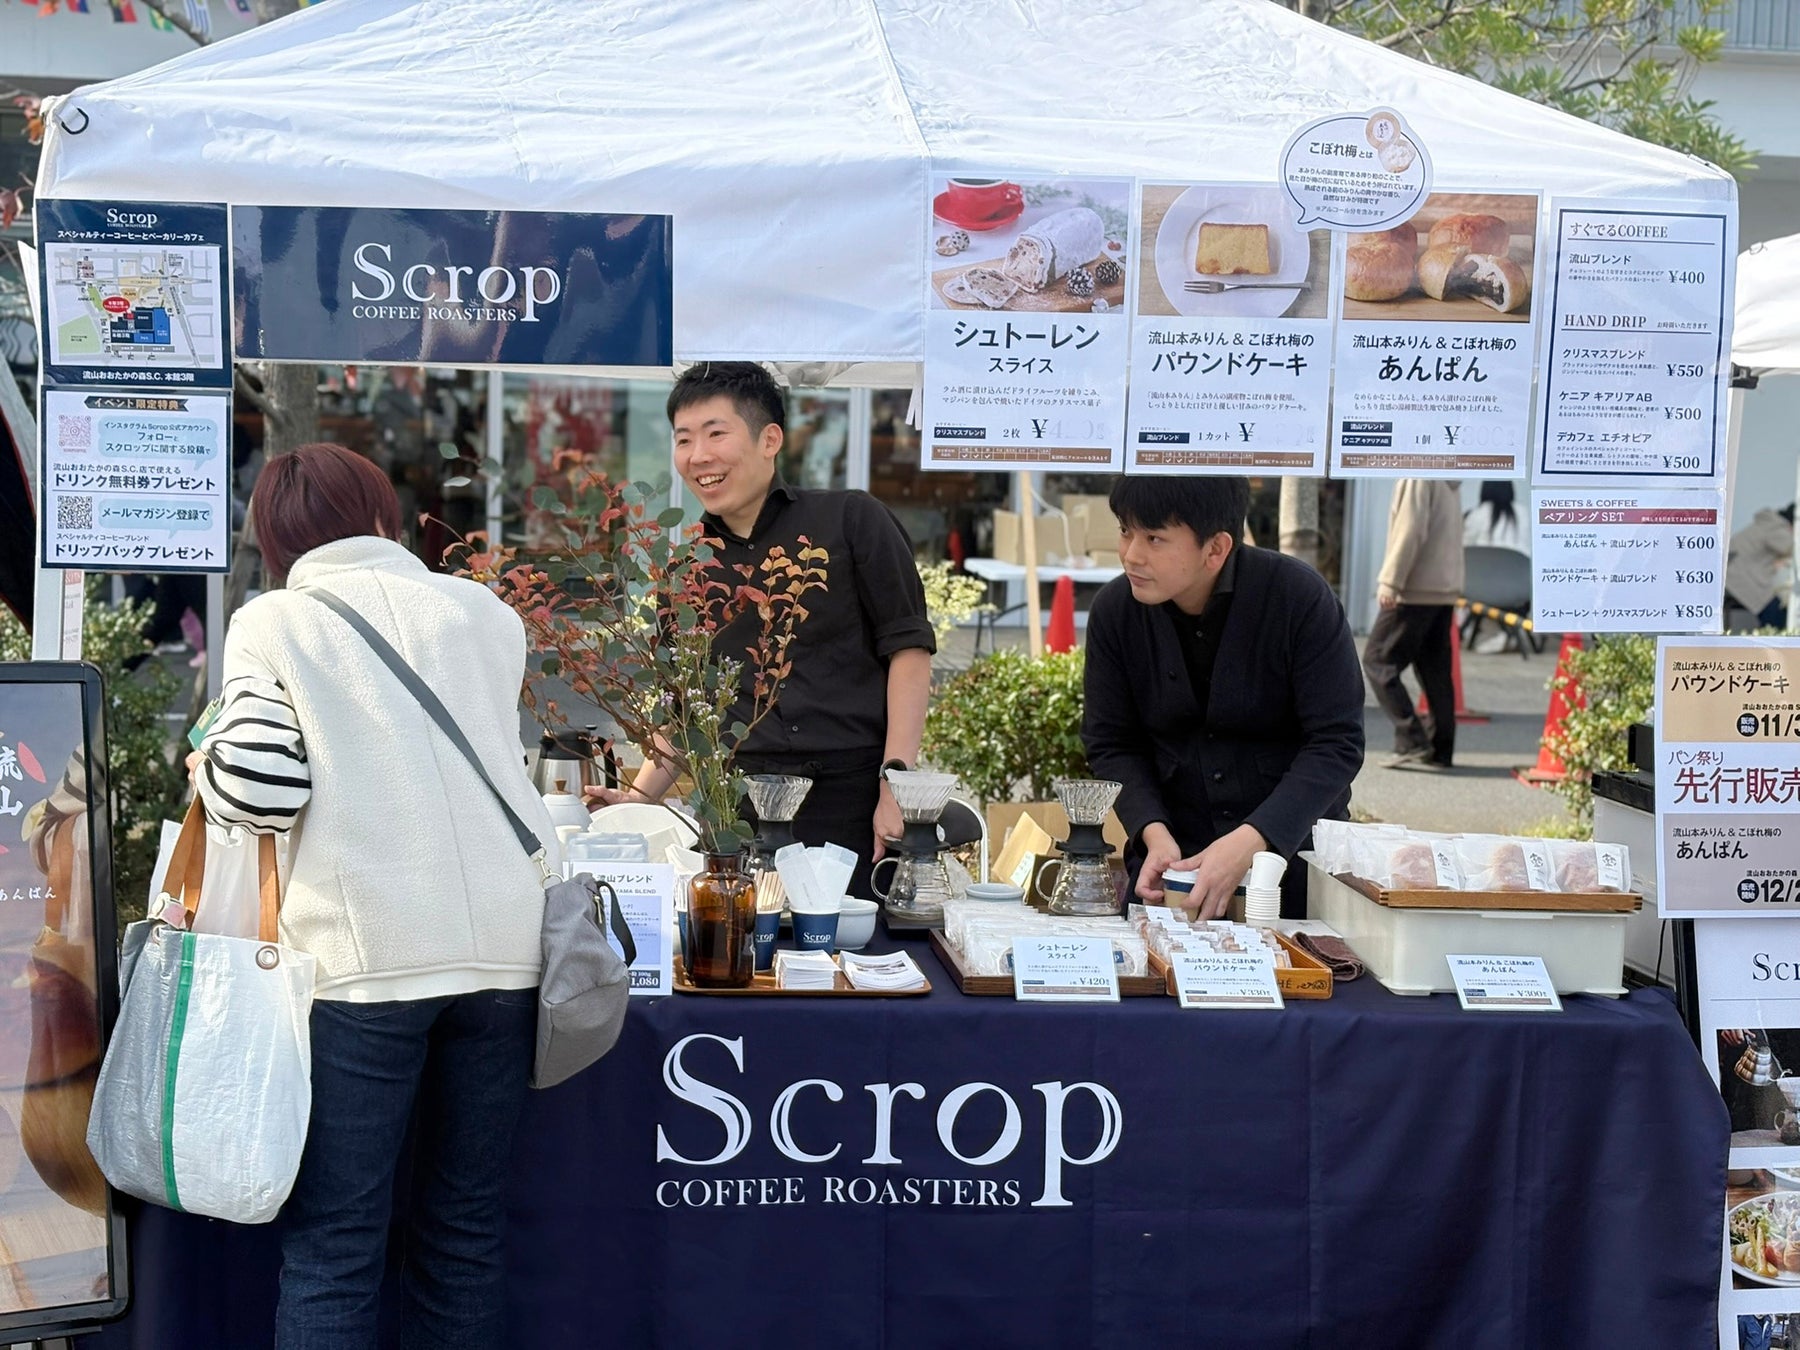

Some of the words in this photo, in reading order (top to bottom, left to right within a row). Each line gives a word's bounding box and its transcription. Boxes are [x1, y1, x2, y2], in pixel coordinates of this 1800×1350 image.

[1309, 142, 1373, 159] こぼれ梅とは
[107, 208, 158, 229] Scrop
[1570, 222, 1668, 238] すぐでるCOFFEE
[1569, 253, 1631, 265] 流山ブレンド
[352, 243, 560, 322] Scrop
[1668, 270, 1705, 284] ¥400
[352, 305, 420, 320] COFFEE
[428, 307, 516, 321] ROASTERS
[1564, 314, 1607, 327] HAND
[1612, 315, 1647, 328] DRIP
[954, 320, 1100, 349] シュトーレン
[1148, 331, 1229, 345] 流山本みりん
[1233, 332, 1244, 344] &
[1248, 332, 1314, 347] こぼれ梅の
[1352, 335, 1432, 349] 流山本みりん
[1435, 336, 1446, 349] &
[1451, 336, 1516, 351] こぼれ梅の
[1563, 348, 1645, 360] クリスマスブレンド
[988, 357, 1054, 374] スライス
[1151, 351, 1308, 376] パウンドケーキ
[1378, 354, 1488, 382] あんぱん
[1666, 363, 1703, 378] ¥550
[94, 397, 179, 409] イベント限定特典
[1559, 390, 1590, 401] ケニア
[1593, 391, 1653, 402] キアリアAB
[1664, 406, 1702, 420] ¥500
[1556, 431, 1595, 442] デカフェ
[1600, 433, 1652, 442] エチオピア
[1662, 455, 1700, 469] ¥500
[55, 474, 216, 490] ドリンク無料券プレゼント
[1540, 499, 1584, 507] SWEETS
[1586, 499, 1593, 507] &
[1596, 499, 1638, 508] COFFEE
[102, 508, 210, 521] メールマガジン登録で
[1544, 511, 1599, 522] ペアリング
[1601, 512, 1625, 522] SET
[1610, 540, 1659, 548] 流山ブレンド
[1675, 536, 1715, 550] ¥600
[1541, 574, 1598, 583] パウンドケーキ
[1610, 574, 1657, 583] 流山ブレンド
[1675, 570, 1714, 584] ¥630
[1541, 609, 1589, 618] シュトーレン
[1601, 608, 1668, 618] クリスマスブレンド
[1675, 605, 1713, 618] ¥850
[1672, 662, 1726, 671] 流山本みりん
[1727, 662, 1735, 671] &
[1737, 662, 1781, 671] こぼれ梅の
[1671, 675, 1789, 693] パウンドケーキ
[1668, 750, 1724, 766] パン祭り
[1672, 828, 1726, 837] 流山本みりん
[1728, 828, 1736, 837] &
[1738, 828, 1781, 837] こぼれ梅の
[1676, 841, 1749, 859] あんぱん
[803, 931, 831, 943] Scrop
[1037, 943, 1088, 951] シュトーレン
[657, 1033, 1123, 1206] Scrop
[657, 1178, 805, 1208] COFFEE
[824, 1177, 1020, 1207] ROASTERS
